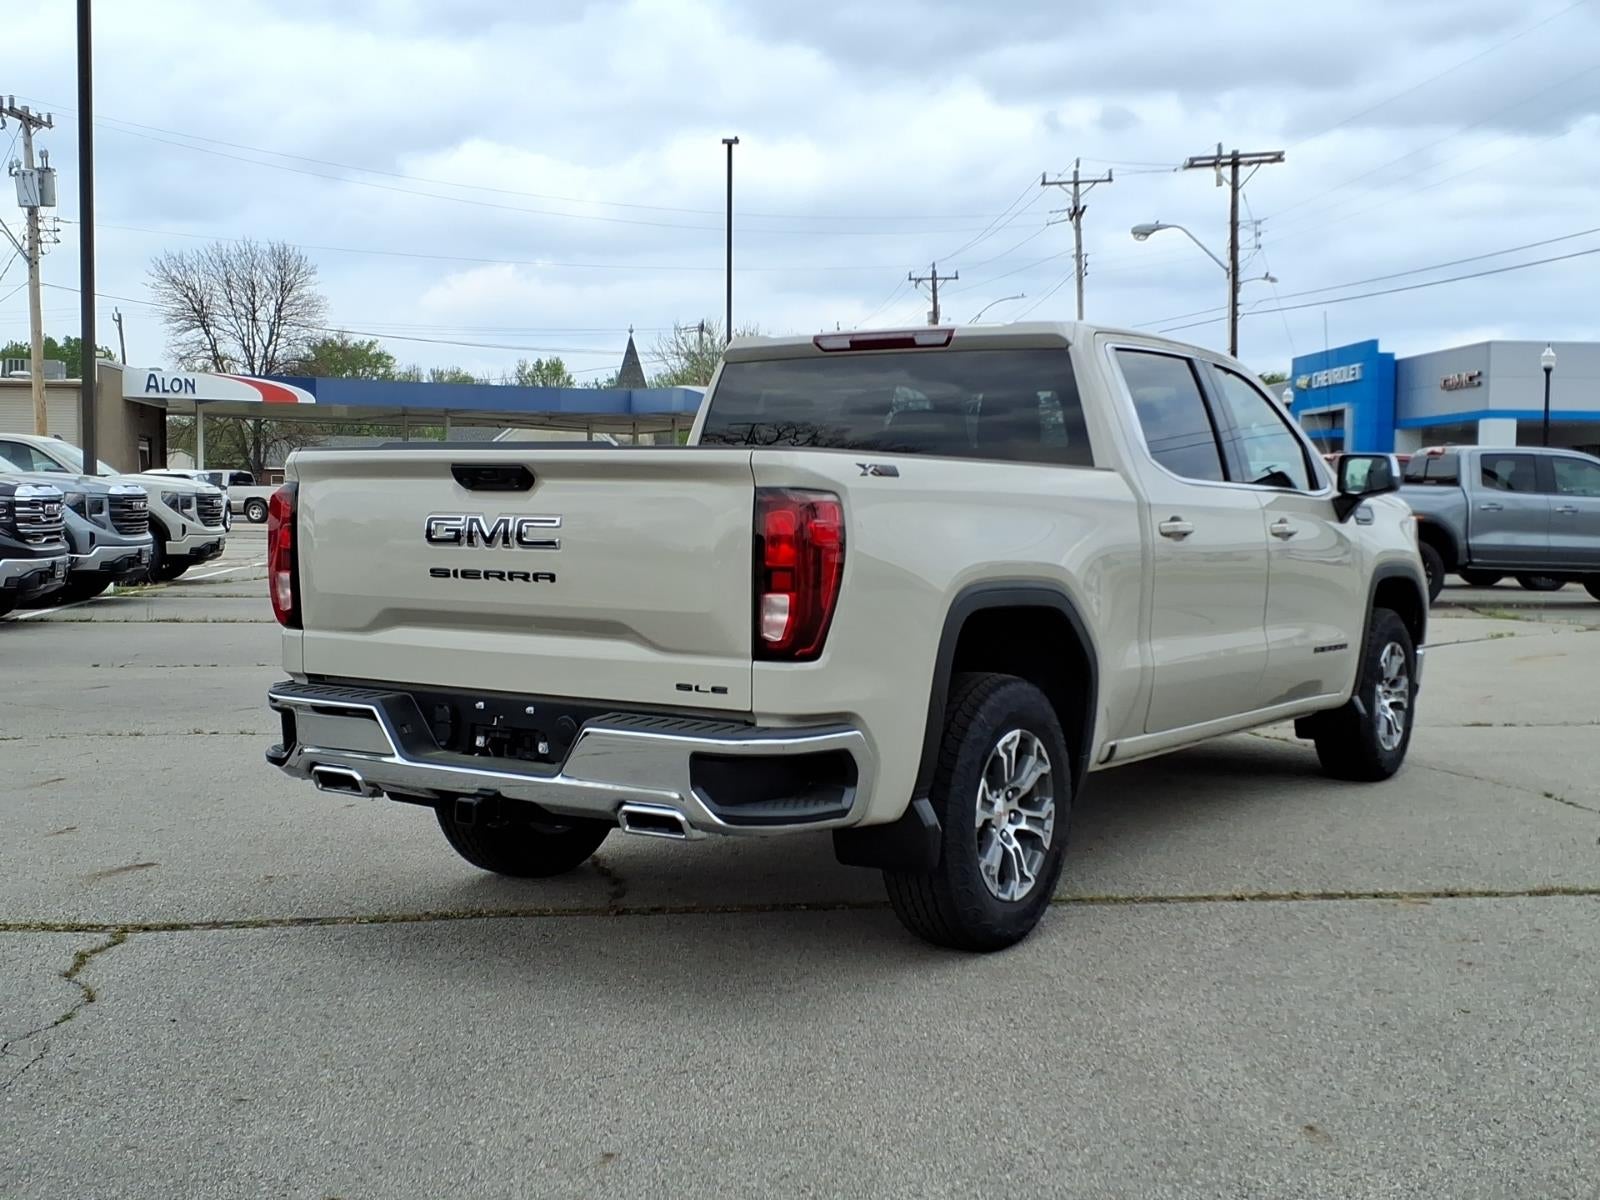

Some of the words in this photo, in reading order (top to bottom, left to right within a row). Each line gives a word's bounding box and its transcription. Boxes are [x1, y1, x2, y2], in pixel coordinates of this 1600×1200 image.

[145, 373, 196, 394] ALON
[1312, 363, 1363, 388] CHEVROLET
[1440, 370, 1482, 391] GMC
[425, 513, 562, 549] GMC
[429, 567, 556, 583] SIERRA
[675, 683, 728, 694] SLE
